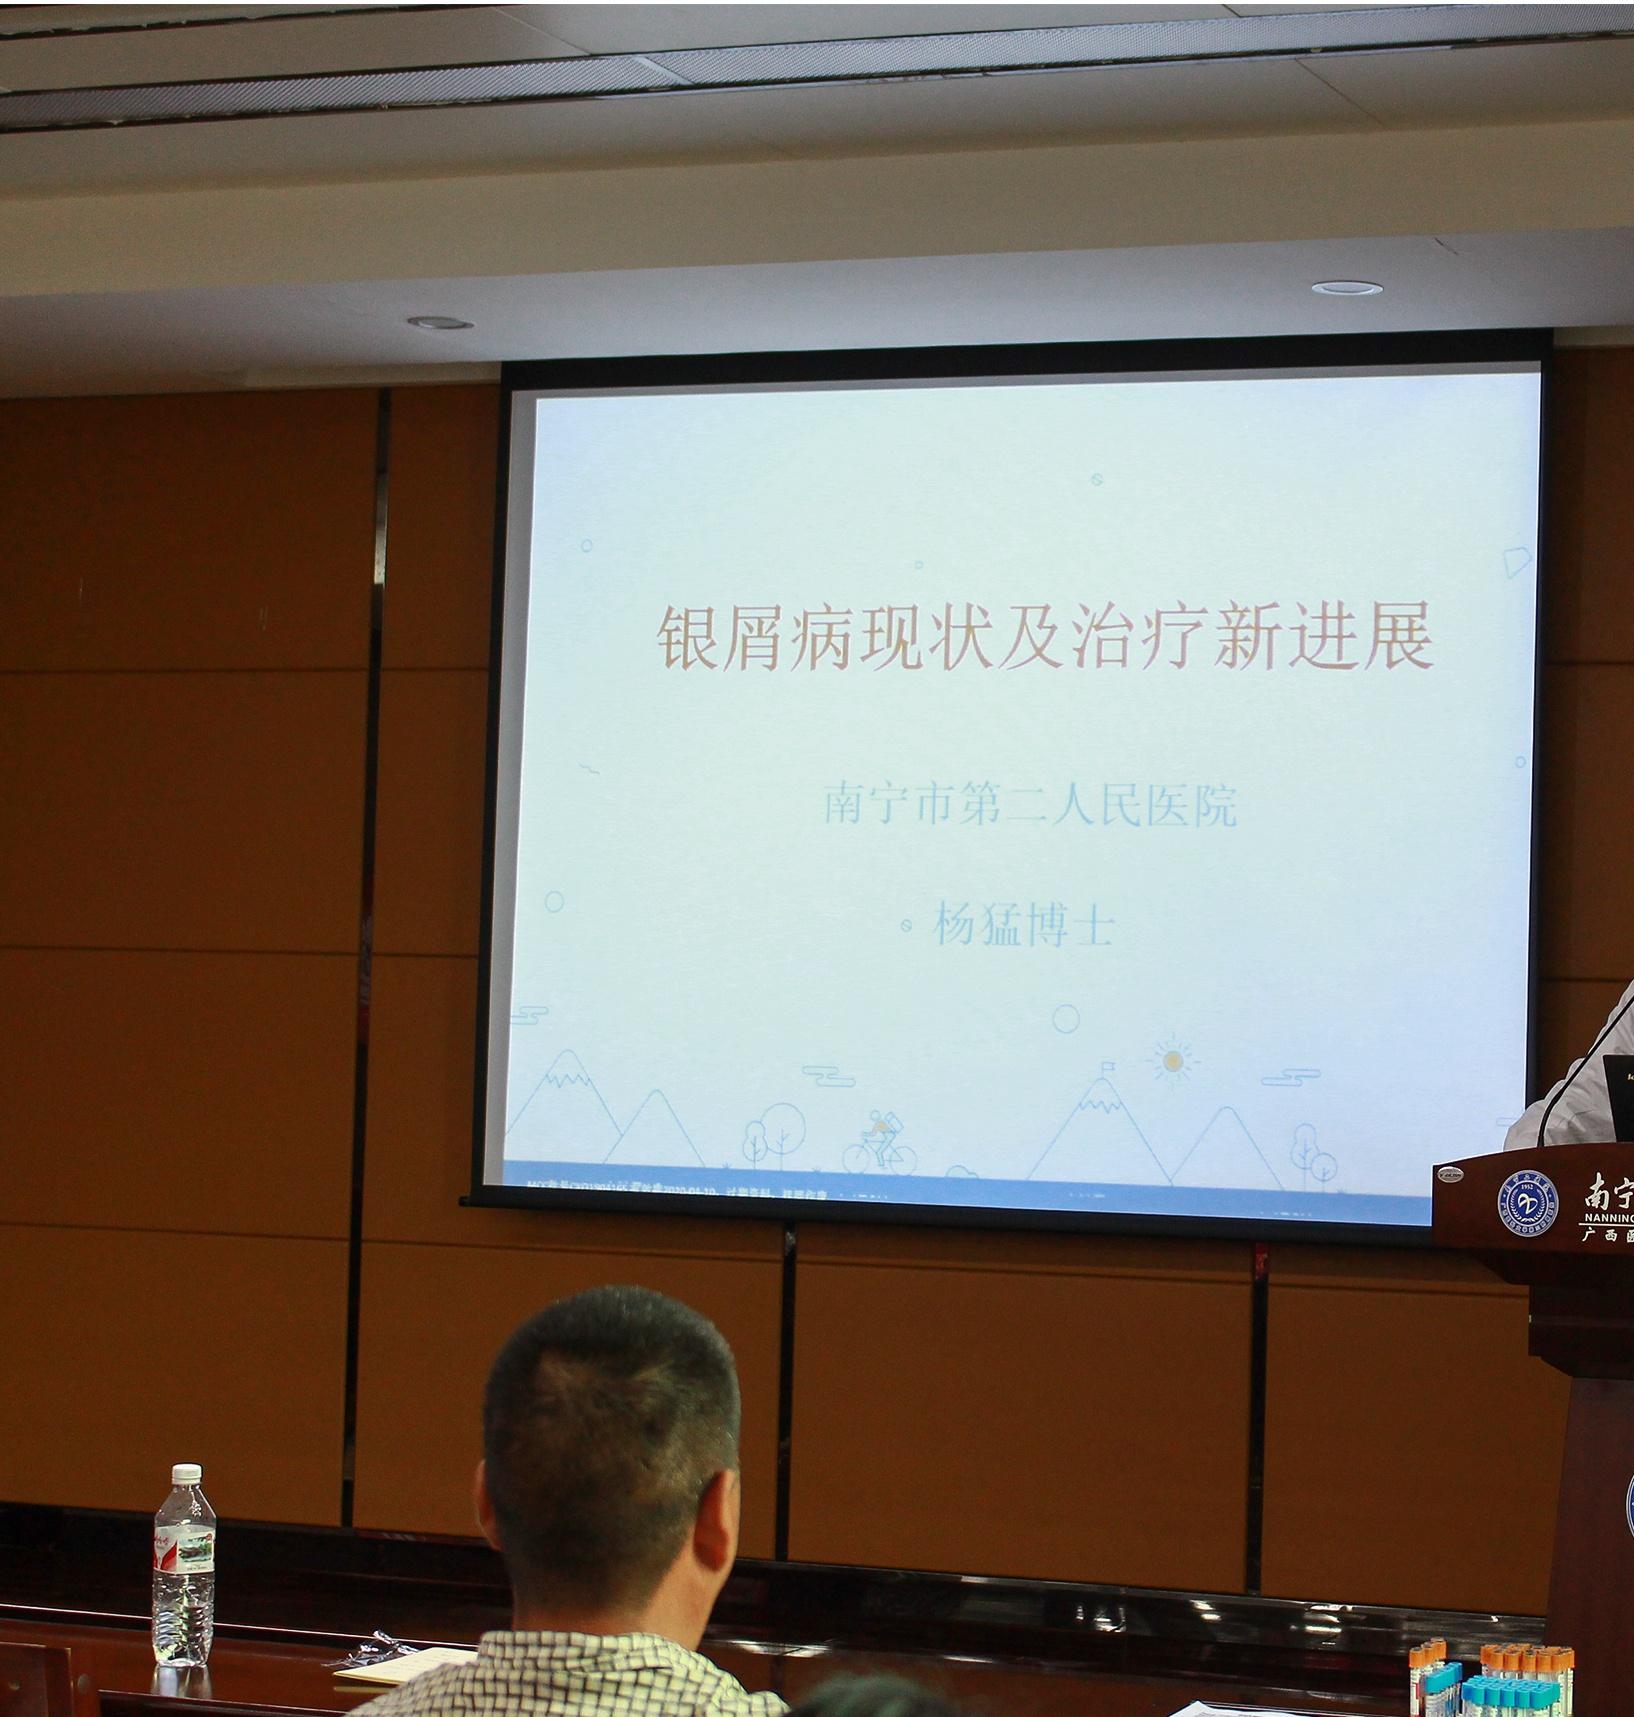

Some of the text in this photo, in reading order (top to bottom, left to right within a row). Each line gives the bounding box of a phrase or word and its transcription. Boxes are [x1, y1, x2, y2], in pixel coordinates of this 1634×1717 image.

[656, 599, 1436, 673] 银屑病现状及治疗新进展
[823, 780, 1239, 830] 南宁市第二人民医院
[933, 901, 1116, 950] 杨猛博士
